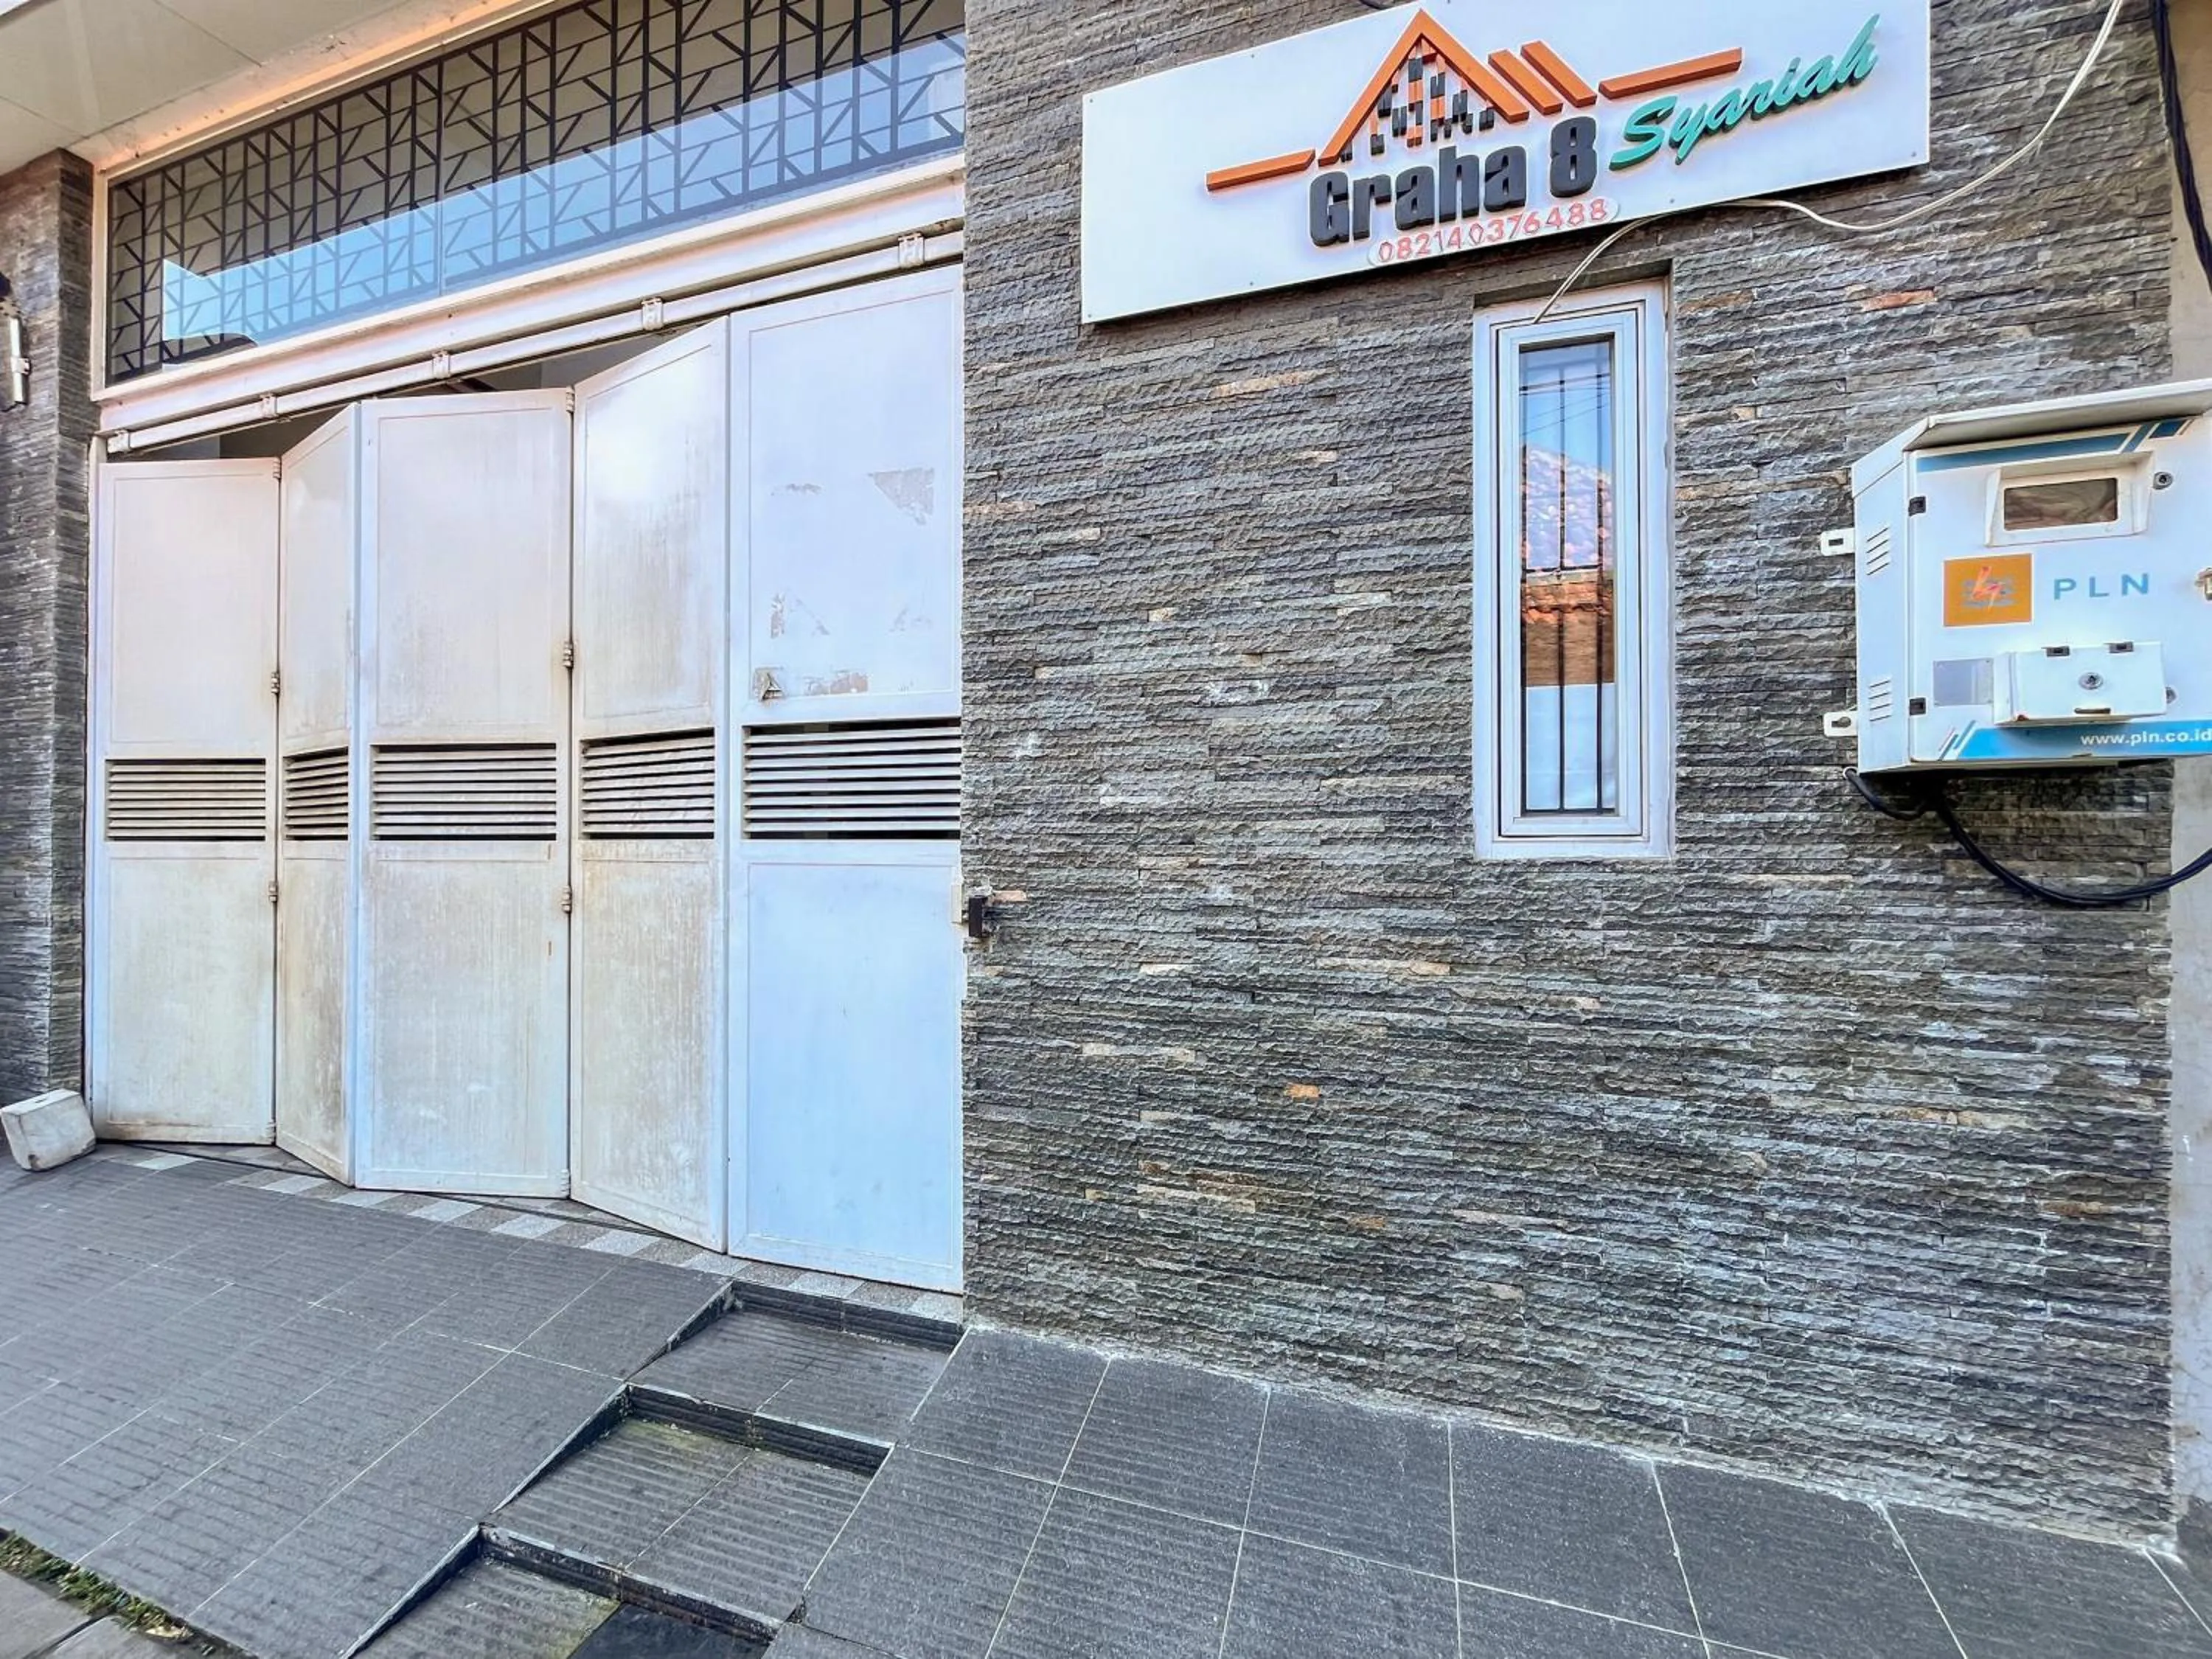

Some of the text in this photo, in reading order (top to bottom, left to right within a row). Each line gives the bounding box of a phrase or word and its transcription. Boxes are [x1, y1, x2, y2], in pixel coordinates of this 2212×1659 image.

[1310, 13, 1880, 246] Graha 8 Syariah
[1378, 198, 1607, 263] 082140376488
[2053, 573, 2149, 600] PLN
[2081, 728, 2212, 746] www.pln.co.id
